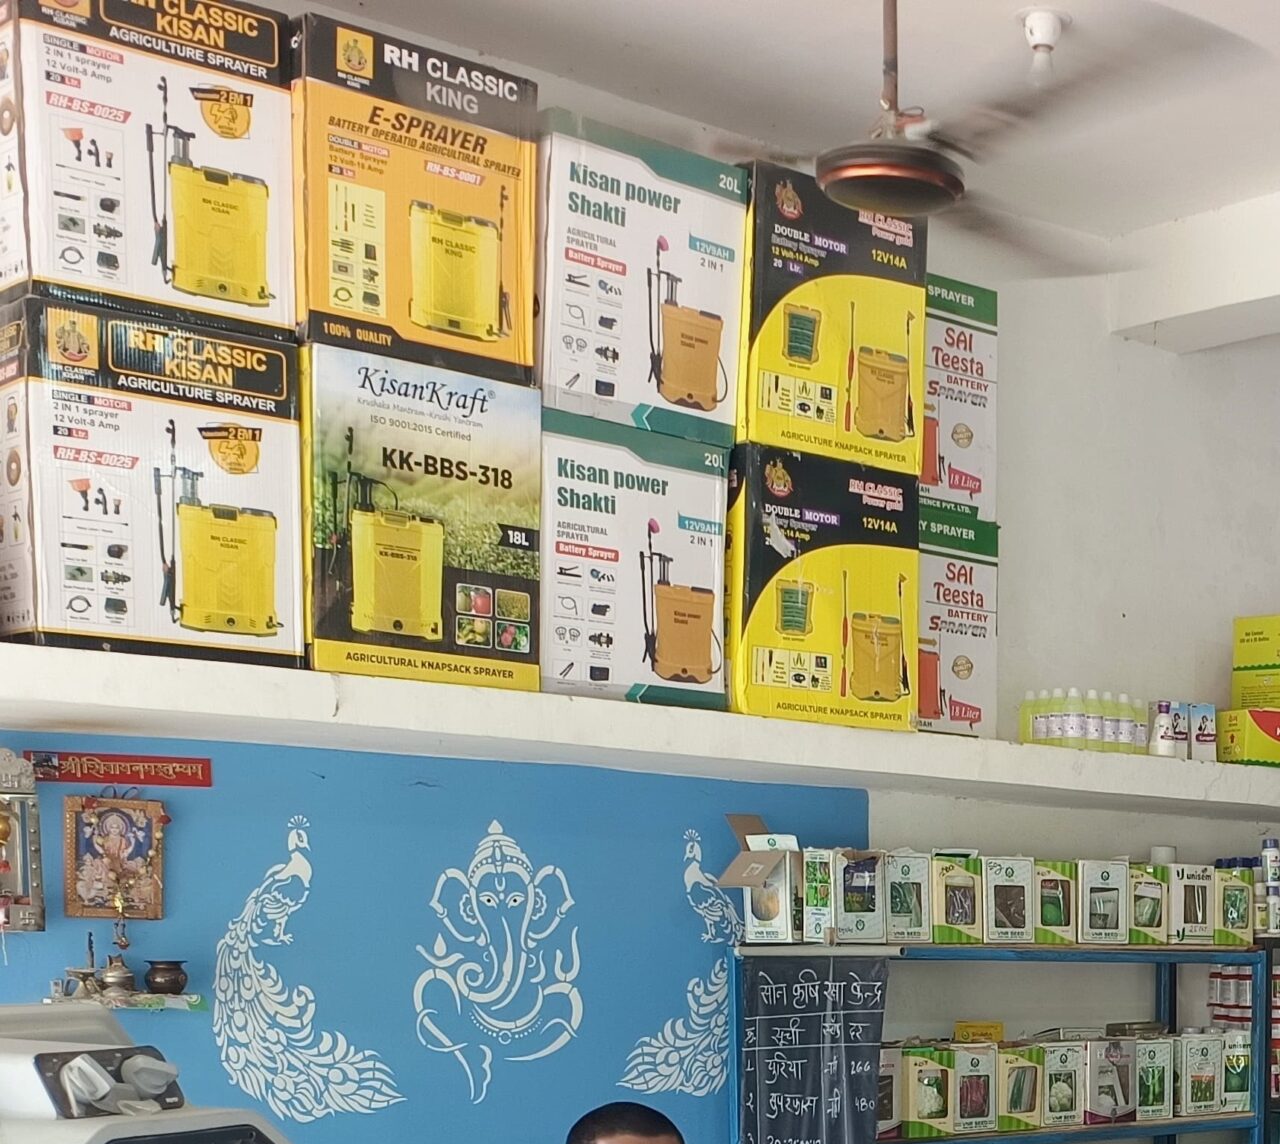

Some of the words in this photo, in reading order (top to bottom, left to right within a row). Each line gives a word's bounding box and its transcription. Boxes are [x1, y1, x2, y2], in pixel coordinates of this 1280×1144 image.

[156, 13, 225, 48] KISAN
[165, 0, 258, 37] CLASSIC
[44, 34, 80, 51] SINGLE
[86, 46, 122, 64] MOTOR
[109, 26, 204, 62] AGRICULTURE
[207, 49, 267, 79] SPRAYER
[46, 59, 55, 68] 12
[90, 71, 112, 84] Amp
[76, 54, 111, 72] sprayer
[383, 43, 419, 73] RH
[425, 57, 518, 102] CLASSIC
[48, 93, 126, 122] RH-BS-0025
[426, 82, 479, 115] KING
[368, 105, 488, 156] E-SPRAYER
[328, 115, 369, 137] BATTERY
[483, 158, 522, 178] SPRAYER
[329, 136, 359, 149] DOUBLE
[361, 143, 389, 157] MOTOR
[570, 161, 621, 196] Kisan
[625, 182, 681, 214] power
[719, 174, 742, 194] 20L
[568, 191, 626, 228] Shakti
[566, 226, 617, 248] AGRICULTURAL
[566, 235, 598, 251] SPRAYER
[774, 224, 810, 243] DOUBLE
[814, 233, 847, 254] MOTOR
[568, 250, 596, 266] Battery
[597, 256, 624, 273] Sprayer
[708, 259, 718, 270] IN
[871, 249, 908, 270] 12V14A
[927, 284, 975, 308] SPRAYER
[323, 322, 351, 339] 100%
[356, 328, 392, 347] QUALITY
[944, 326, 973, 352] SAI
[172, 336, 268, 373] CLASSIC
[932, 345, 984, 378] Teesta
[164, 358, 234, 386] KISAN
[946, 374, 989, 392] BATTERY
[52, 391, 87, 403] SINGLE
[93, 397, 129, 410] MOTOR
[117, 373, 213, 402] AGRICULTURE
[215, 390, 276, 412] SPRAYER
[357, 366, 490, 418] KisanKraft
[54, 414, 65, 423] 12
[98, 421, 120, 432] Amp
[82, 407, 119, 422] sprayer
[370, 415, 386, 426] ISO
[435, 426, 472, 442] Certified
[57, 448, 134, 467] RH-BS-0025
[780, 430, 834, 449] AGRICULTURE
[834, 441, 873, 457] KNAPSACK
[874, 448, 907, 464] SPRAYER
[381, 446, 513, 490] KK-BBS-318
[704, 453, 725, 469] 20L
[557, 457, 609, 485] Kisan
[614, 472, 669, 496] power
[950, 471, 957, 486] 18
[958, 474, 980, 490] Liter
[557, 486, 616, 515] Shakti
[764, 503, 800, 518] DOUBLE
[804, 511, 838, 525] MOTOR
[862, 516, 898, 534] 12V14A
[507, 529, 530, 547] 18L
[556, 530, 589, 542] SPRAYER
[557, 521, 608, 536] AGRICULTURAL
[930, 520, 975, 541] SPRAYER
[559, 542, 586, 556] Battery
[587, 546, 616, 559] Sprayer
[697, 537, 707, 546] IN
[946, 562, 973, 586] SAI
[933, 581, 984, 608] Teesta
[948, 609, 988, 624] BATTERY
[346, 651, 419, 669] AGRICULTURAL
[420, 660, 472, 674] KNAPSACK
[473, 666, 514, 680] SPRAYER
[776, 702, 828, 715] AGRICULTURE
[830, 706, 868, 719] KNAPSACK
[870, 710, 902, 721] SPRAYER
[951, 704, 958, 717] 18
[958, 706, 980, 720] Liter
[1186, 870, 1212, 881] unisem
